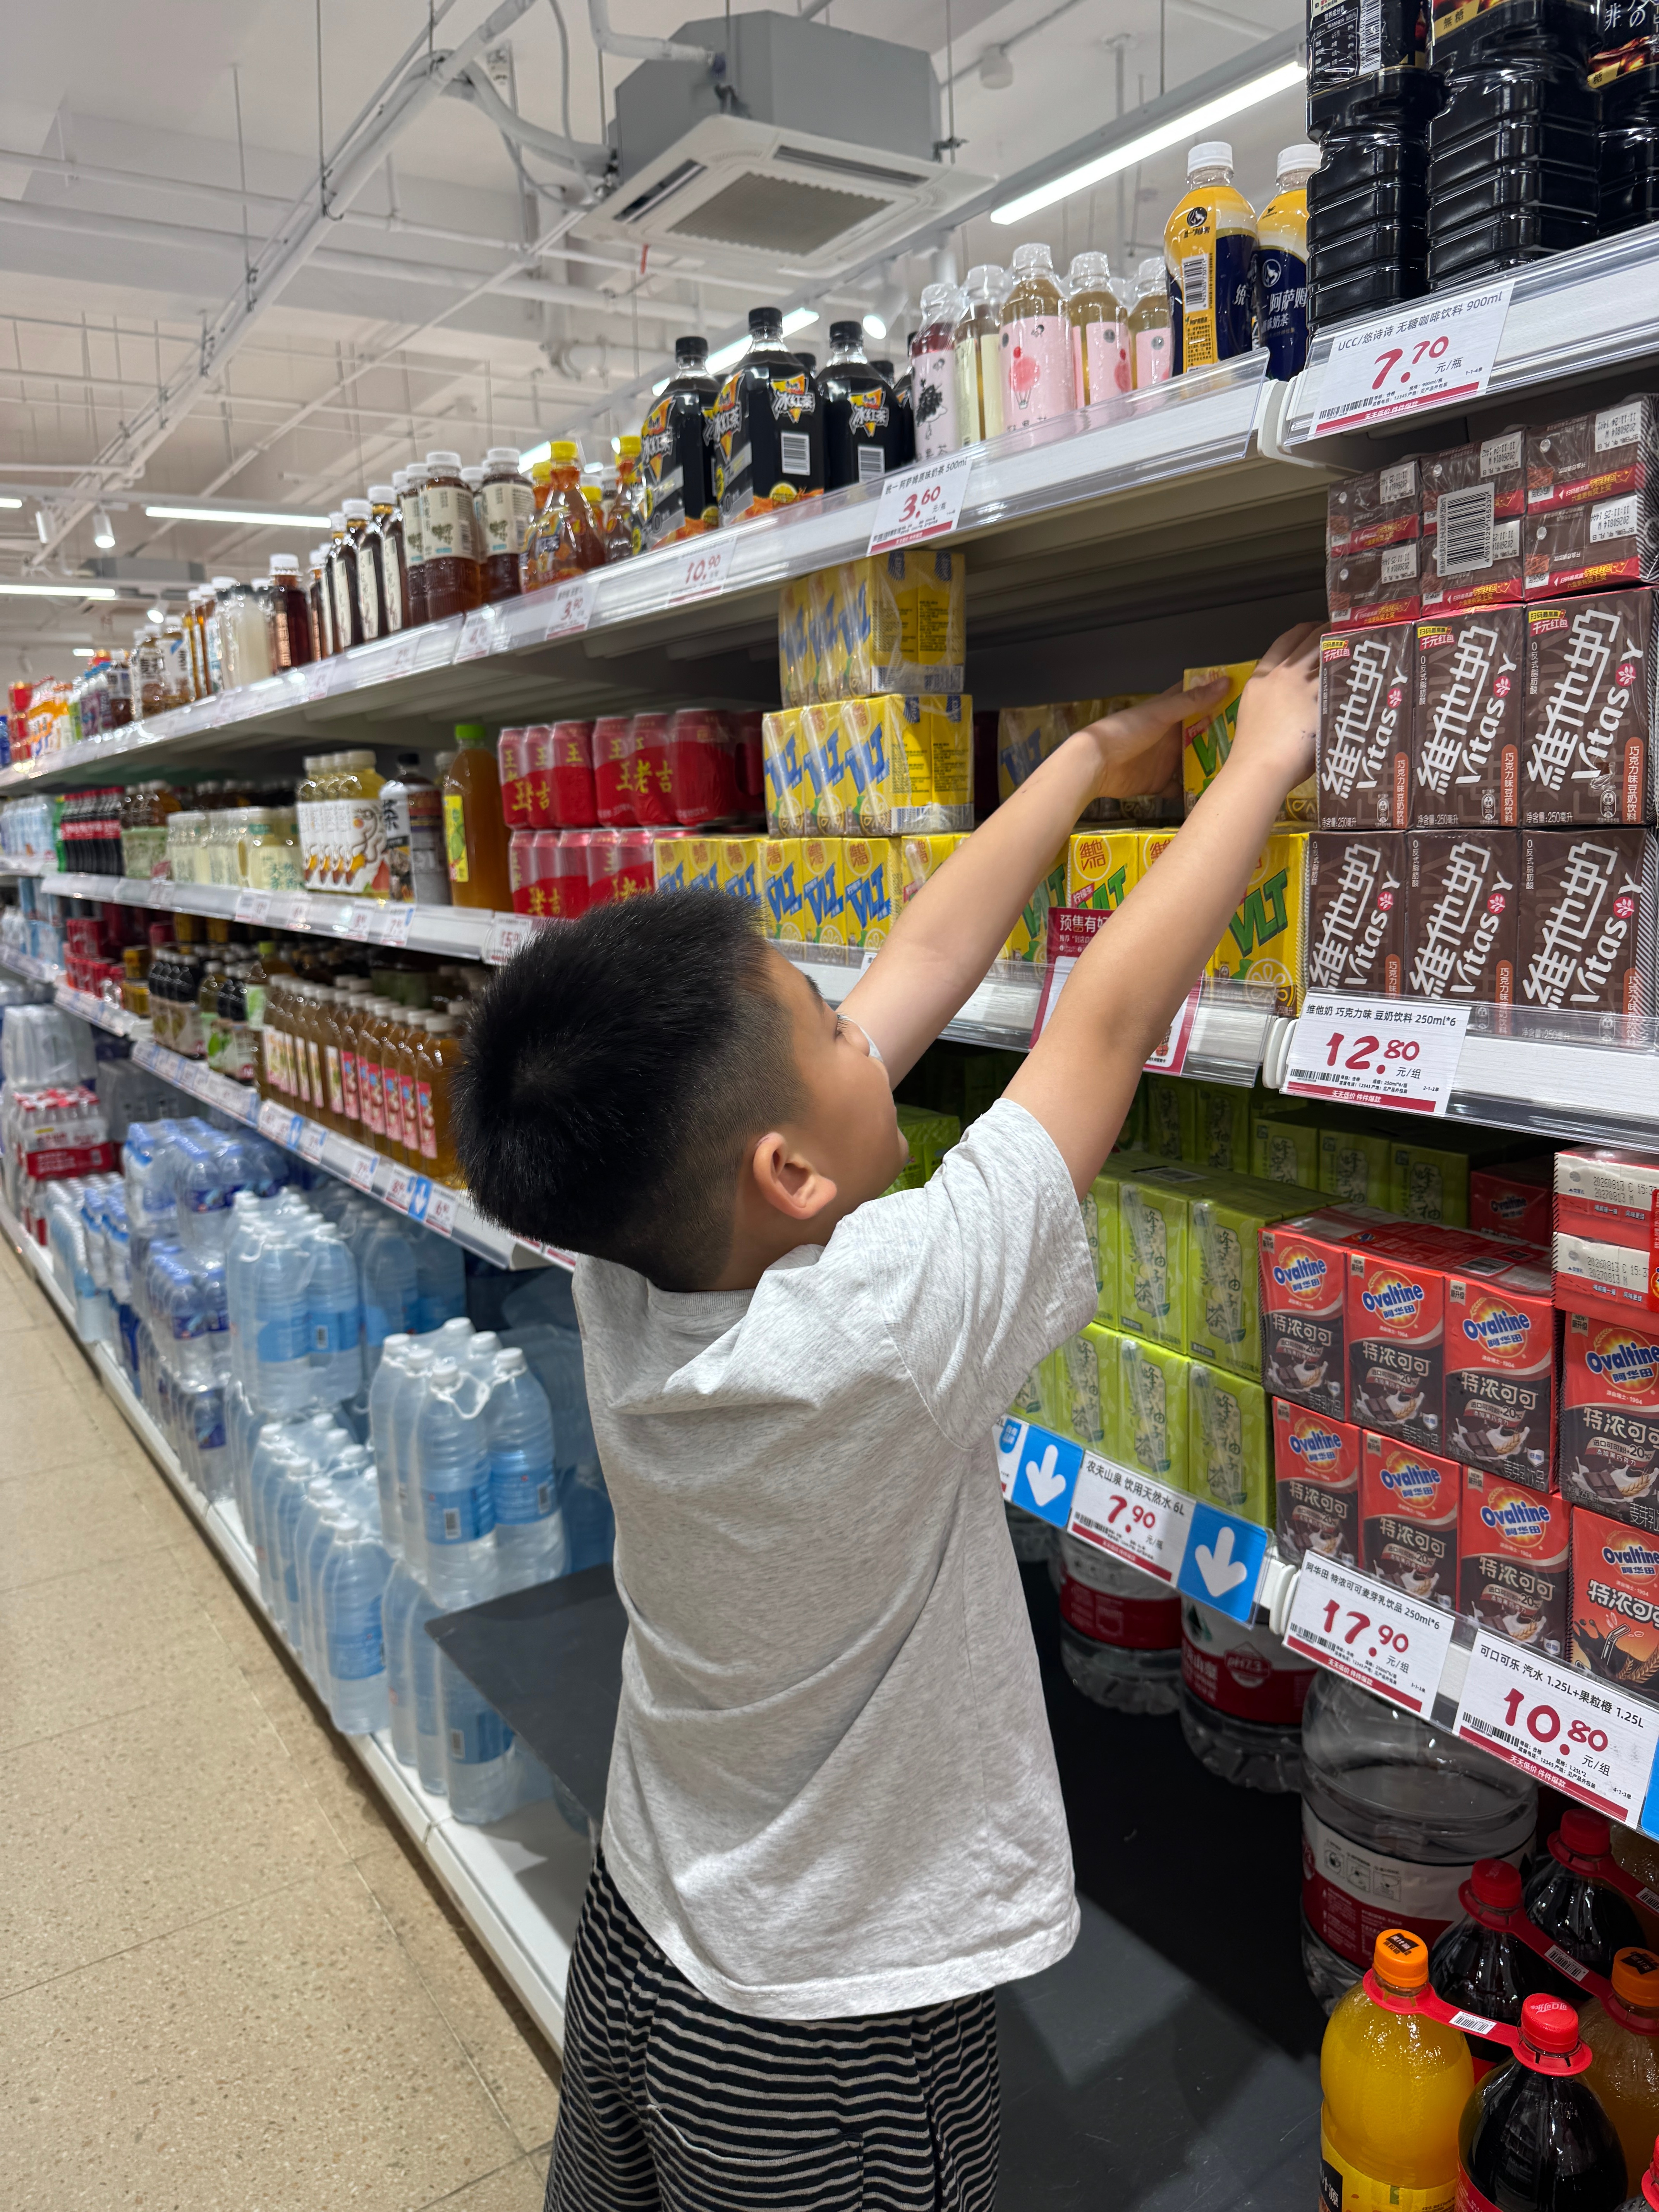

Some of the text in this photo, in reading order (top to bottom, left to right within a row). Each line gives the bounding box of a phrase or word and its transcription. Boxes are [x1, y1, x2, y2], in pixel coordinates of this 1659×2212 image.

[1338, 291, 1503, 351] UCC/悠诗诗 无糖咖啡饮料 900ml
[1372, 336, 1449, 390] 7.70
[1435, 357, 1463, 374] 元/瓶
[899, 486, 941, 522] 3.60
[1421, 635, 1455, 649] 千元红包
[1532, 619, 1568, 635] 千元红包
[1324, 647, 1350, 661] 千元红包
[616, 758, 673, 794] 王老吉
[1396, 760, 1407, 826] 巧克力味豆奶饮料
[1504, 752, 1515, 824] 巧克力味豆奶饮料
[1626, 745, 1639, 822] 巧克力味豆奶饮料
[1525, 839, 1534, 890] 0反式脂肪酸
[1388, 961, 1398, 998] 巧克力味
[1306, 1004, 1333, 1016] 维他奶
[1335, 1007, 1372, 1020] 巧克力味
[1374, 1010, 1412, 1023] 豆奶饮料
[1326, 1032, 1420, 1075] 12.80
[1396, 1067, 1421, 1079] 元/组
[1273, 1257, 1327, 1286] Ovaltine
[1362, 1282, 1424, 1311] Ovaltine
[1273, 1312, 1333, 1347] 特浓可可
[1463, 1310, 1530, 1340] Ovaltine
[1362, 1340, 1431, 1377] 特浓可可
[1587, 1341, 1659, 1374] Ovaltine
[1461, 1370, 1539, 1411] 特浓可可
[1289, 1430, 1342, 1455] Ovaltine
[1086, 1460, 1185, 1516] 农夫山泉 饮用天然水 6L
[1381, 1464, 1441, 1489] Ovaltine
[1107, 1494, 1156, 1534] 7.90
[1289, 1480, 1348, 1519] 特浓可可
[1480, 1499, 1550, 1527] Ovaltine
[1379, 1516, 1447, 1559] 特浓可可
[1602, 1545, 1659, 1565] Ovaltine
[1305, 1561, 1329, 1580] 阿华田
[1330, 1572, 1402, 1614] 特浓可可麦芽乳饮品
[1479, 1555, 1556, 1602] 特浓可可
[1323, 1599, 1409, 1657] 17.90
[1386, 1655, 1410, 1674] 元/组
[1480, 1644, 1644, 1729] 可口可乐 汽水 1.25L+果粒橙 1.25L
[1503, 1687, 1609, 1756] 10.80
[1510, 1754, 1566, 1788] 天天低价 件件爆款
[1581, 1754, 1611, 1777] 元/组
